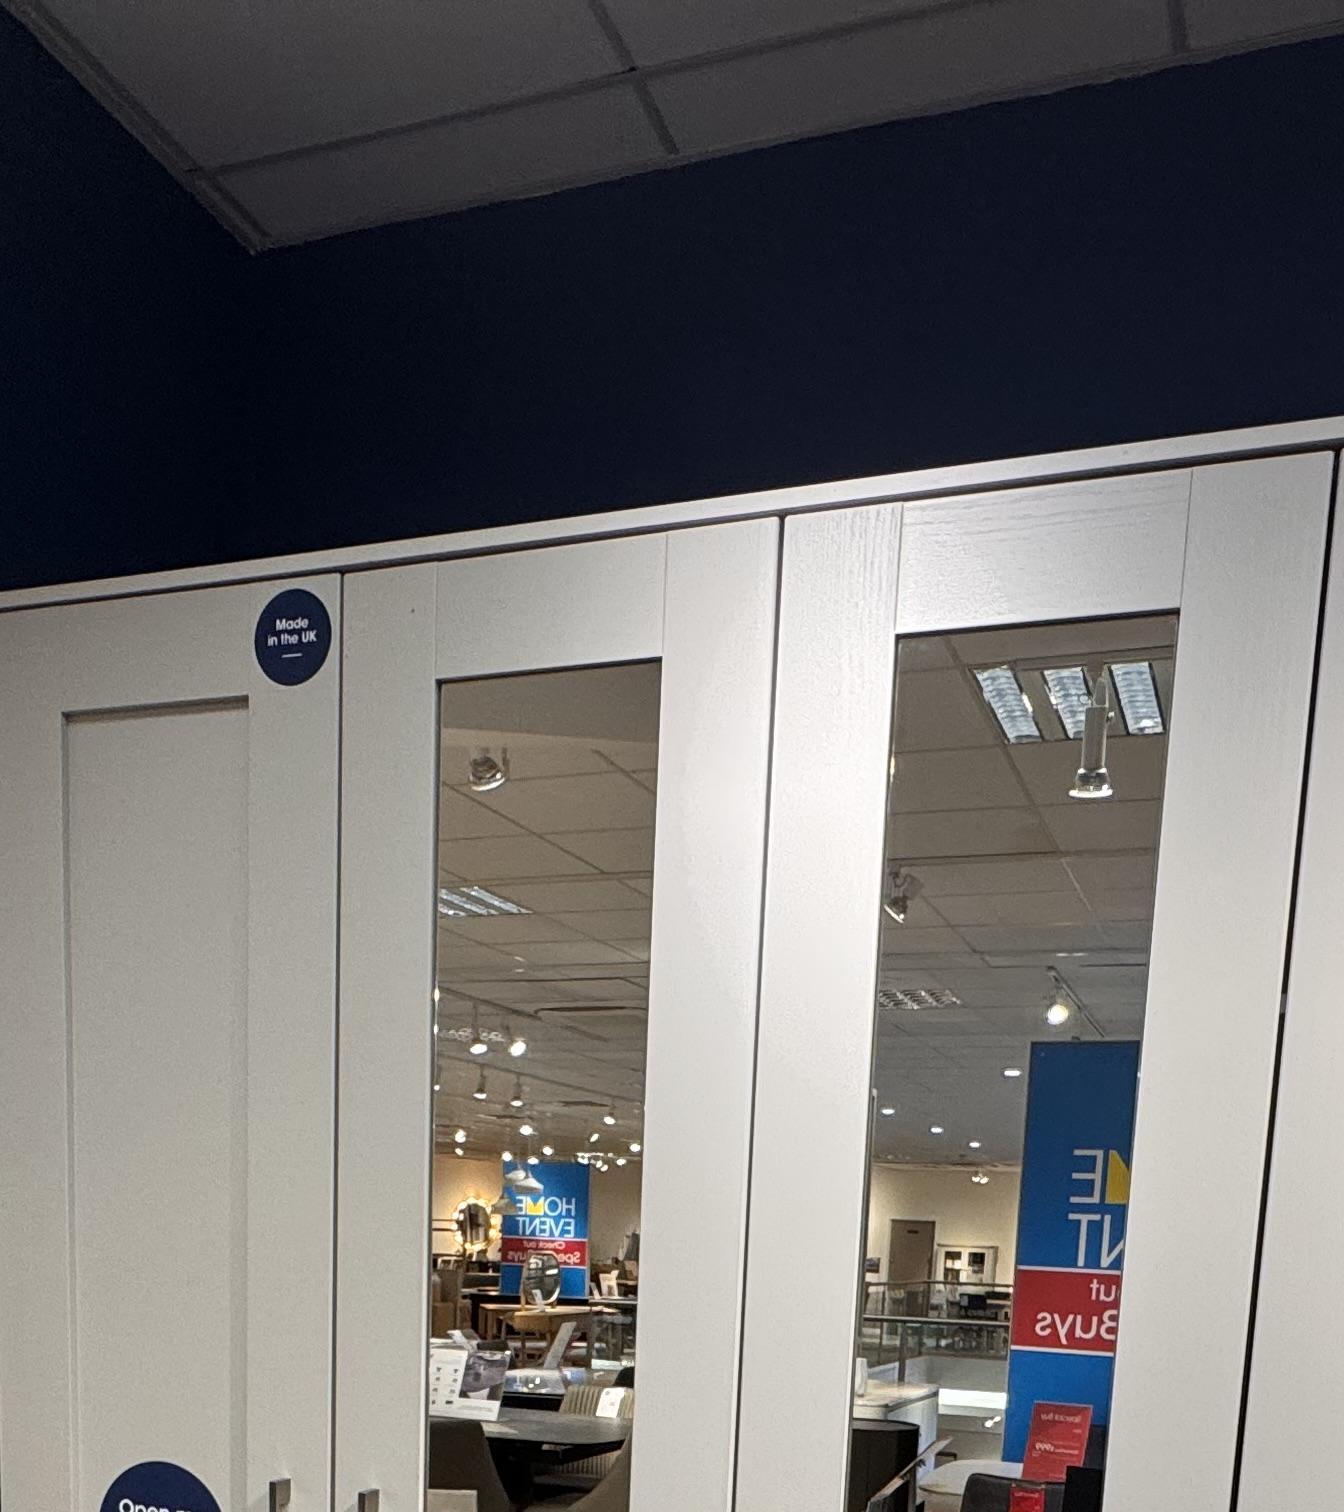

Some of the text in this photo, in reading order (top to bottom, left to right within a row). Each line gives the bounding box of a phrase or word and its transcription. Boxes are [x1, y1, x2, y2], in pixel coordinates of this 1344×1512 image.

[275, 617, 309, 631] Made
[267, 630, 317, 647] in the UK
